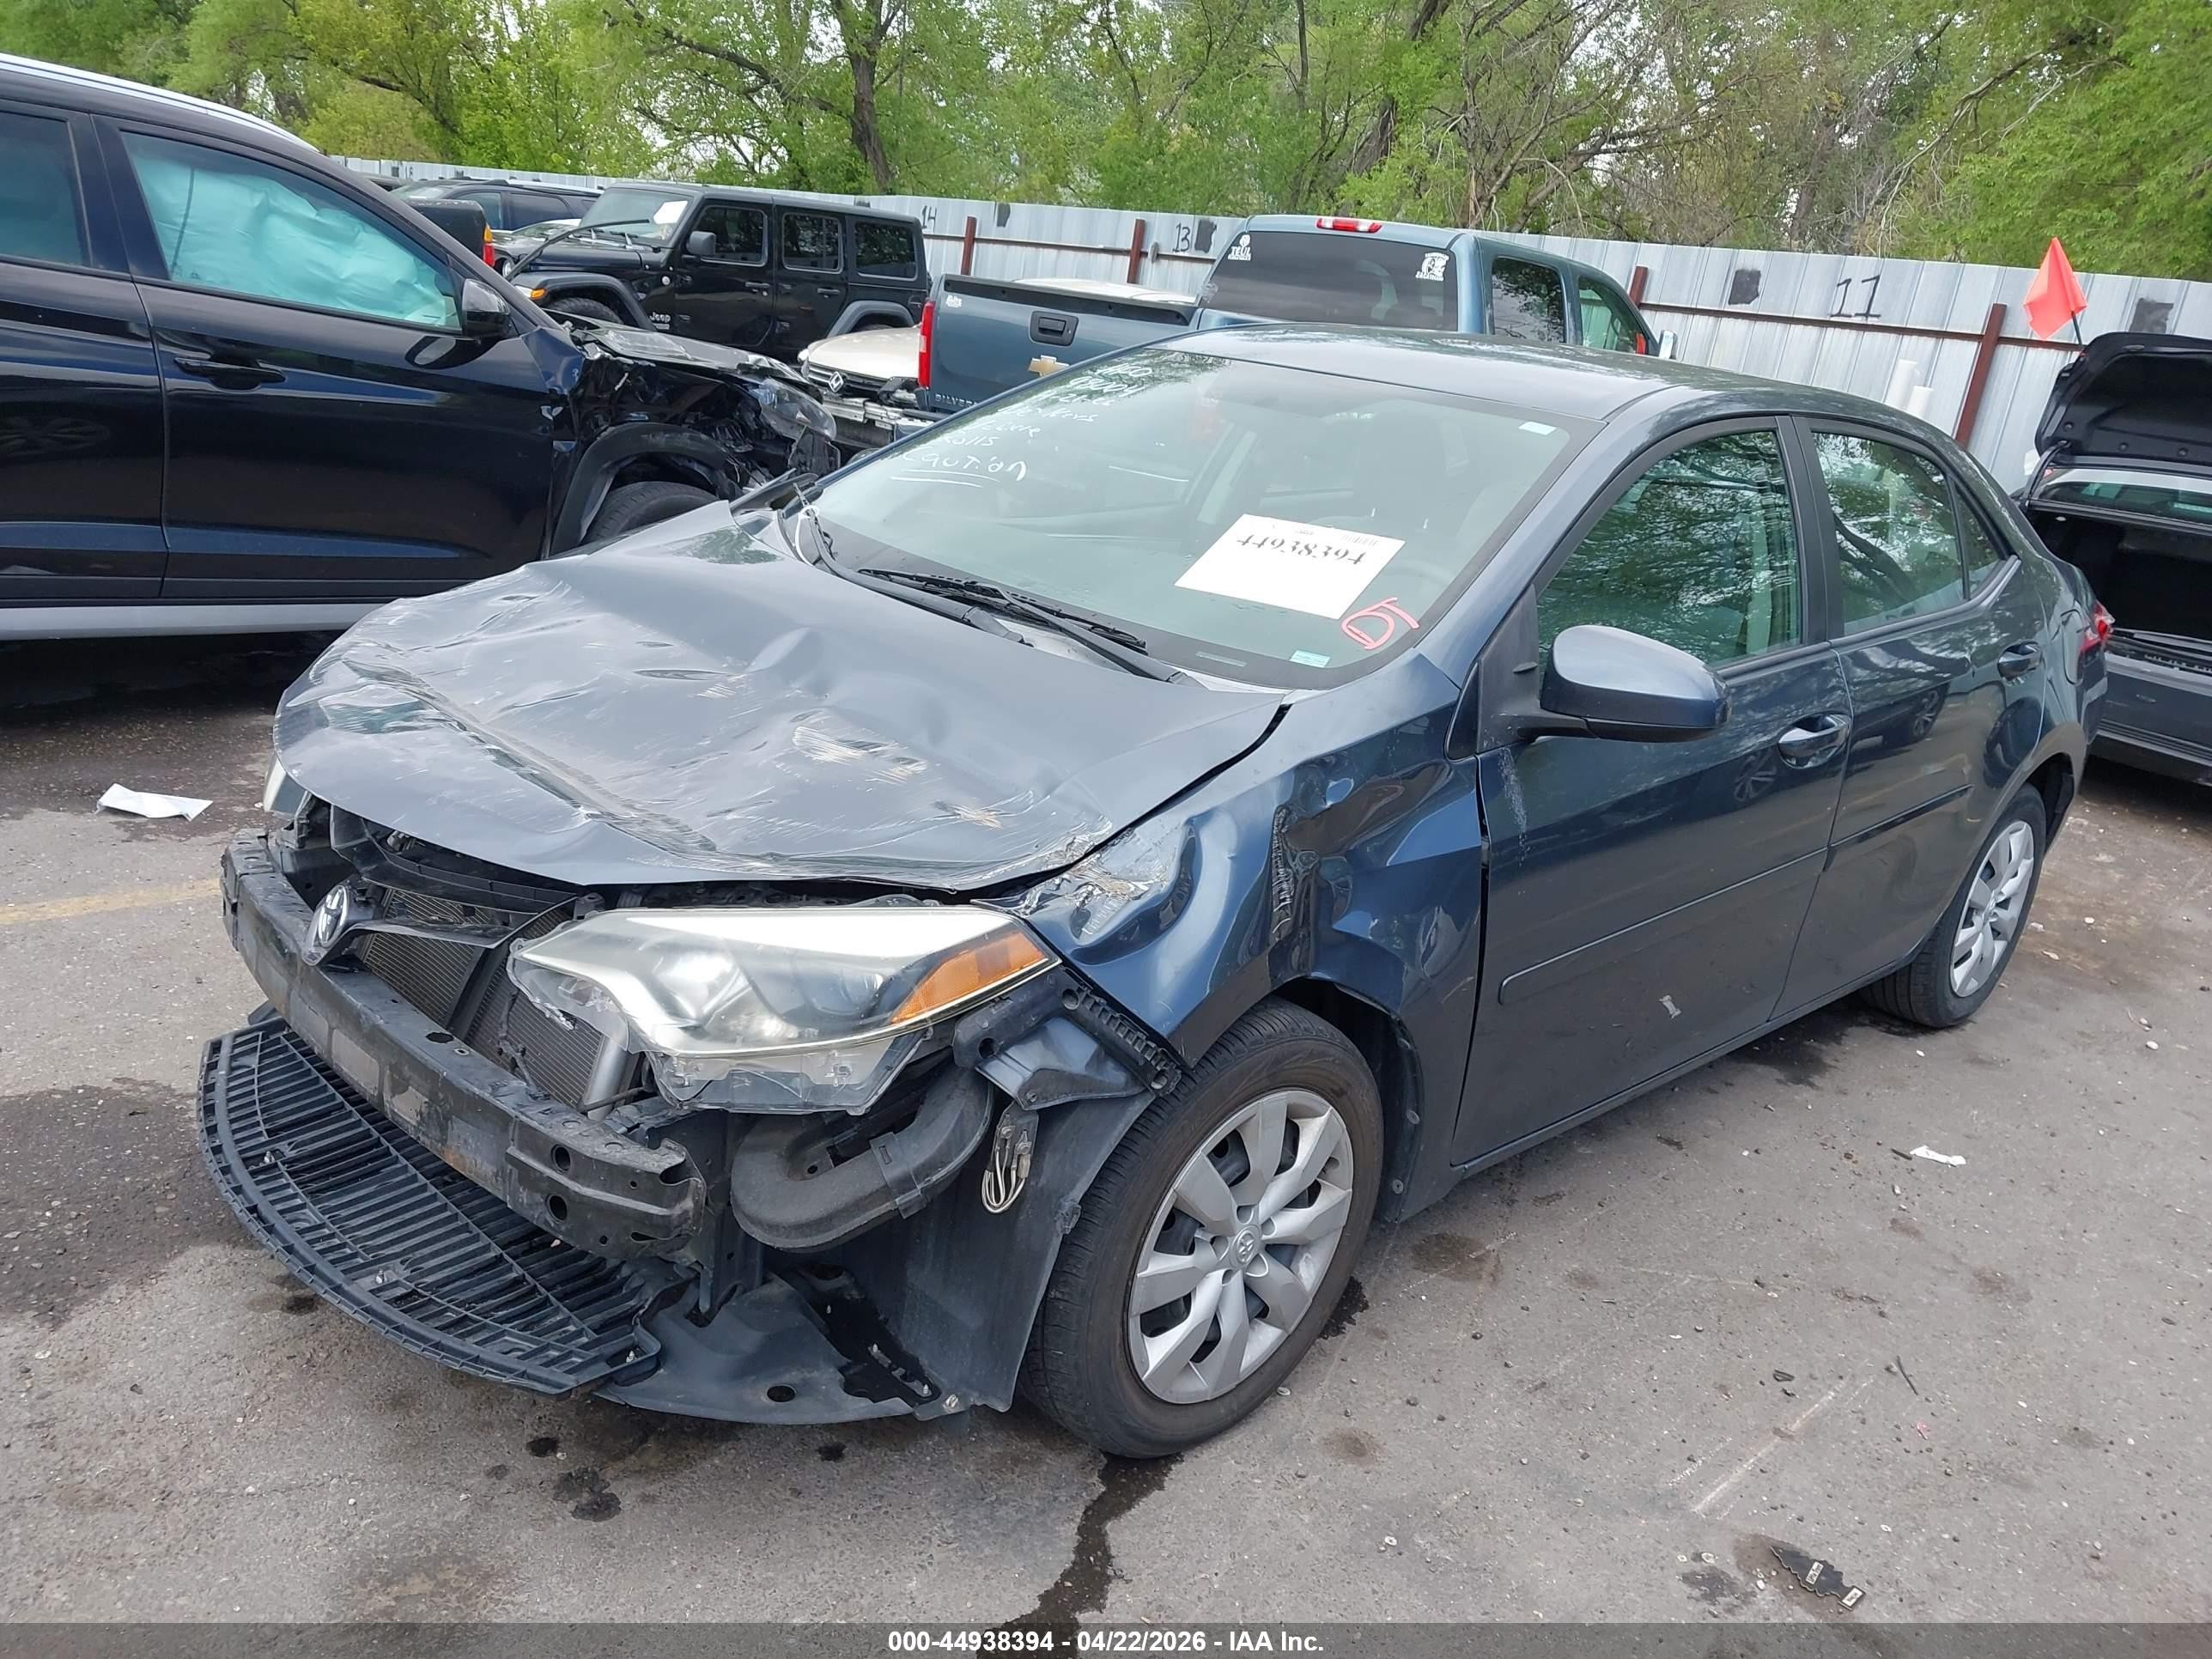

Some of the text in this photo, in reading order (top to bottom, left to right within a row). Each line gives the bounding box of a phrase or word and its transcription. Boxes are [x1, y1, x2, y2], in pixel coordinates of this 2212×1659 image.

[921, 205, 937, 234] 14
[1172, 222, 1190, 252] 13
[1829, 275, 1881, 318] 11
[649, 312, 671, 323] Jeep
[1237, 534, 1366, 565] 44938394
